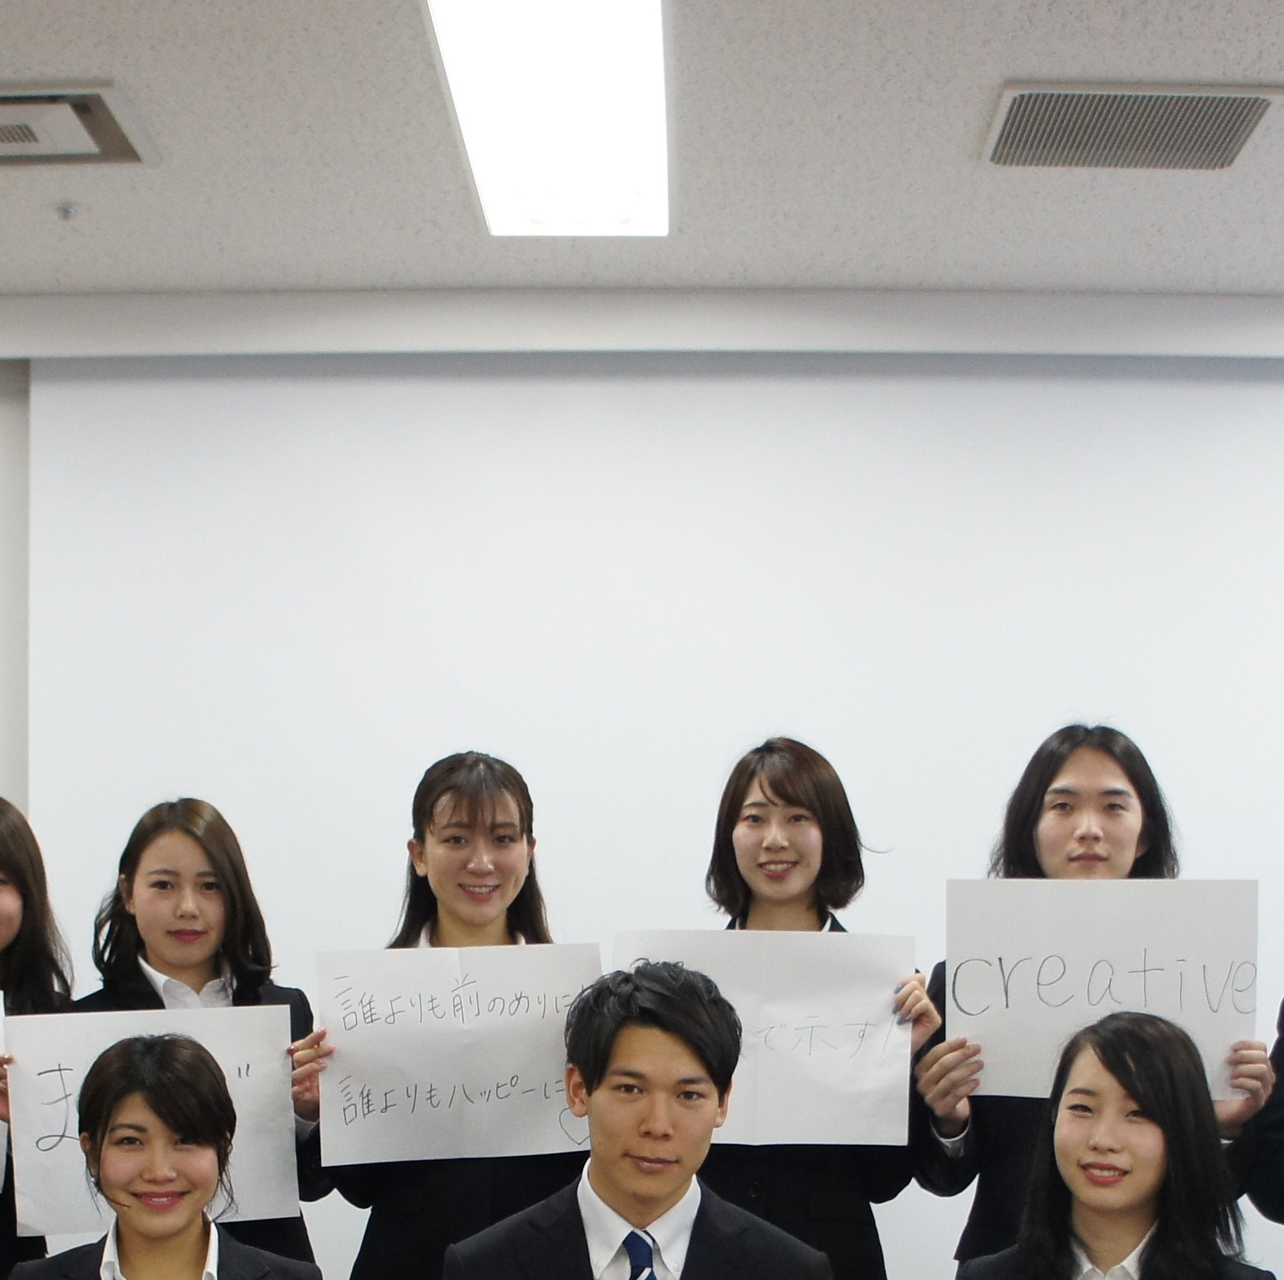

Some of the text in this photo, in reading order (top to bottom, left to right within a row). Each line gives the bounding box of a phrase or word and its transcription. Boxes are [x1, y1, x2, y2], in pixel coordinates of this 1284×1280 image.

[333, 972, 585, 1032] 誰よりも前のめりに
[951, 948, 1258, 1016] creative
[739, 1013, 896, 1060] で示す!
